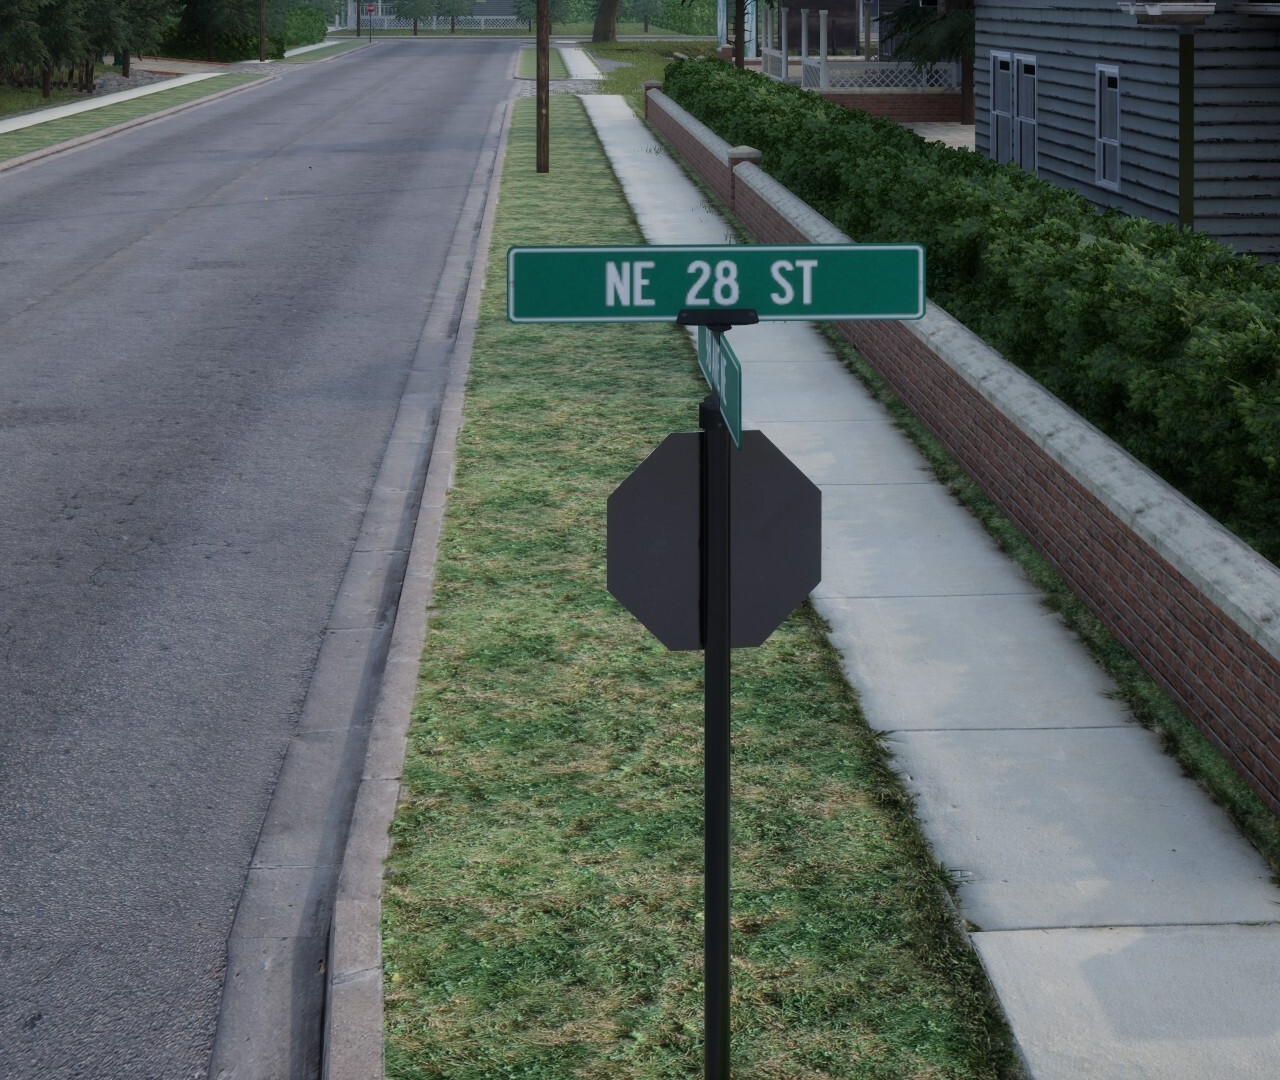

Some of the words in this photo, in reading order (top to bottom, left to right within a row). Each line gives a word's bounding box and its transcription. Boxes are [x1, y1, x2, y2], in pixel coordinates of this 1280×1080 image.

[605, 261, 655, 306] NE
[685, 260, 739, 306] 28
[770, 259, 817, 305] ST
